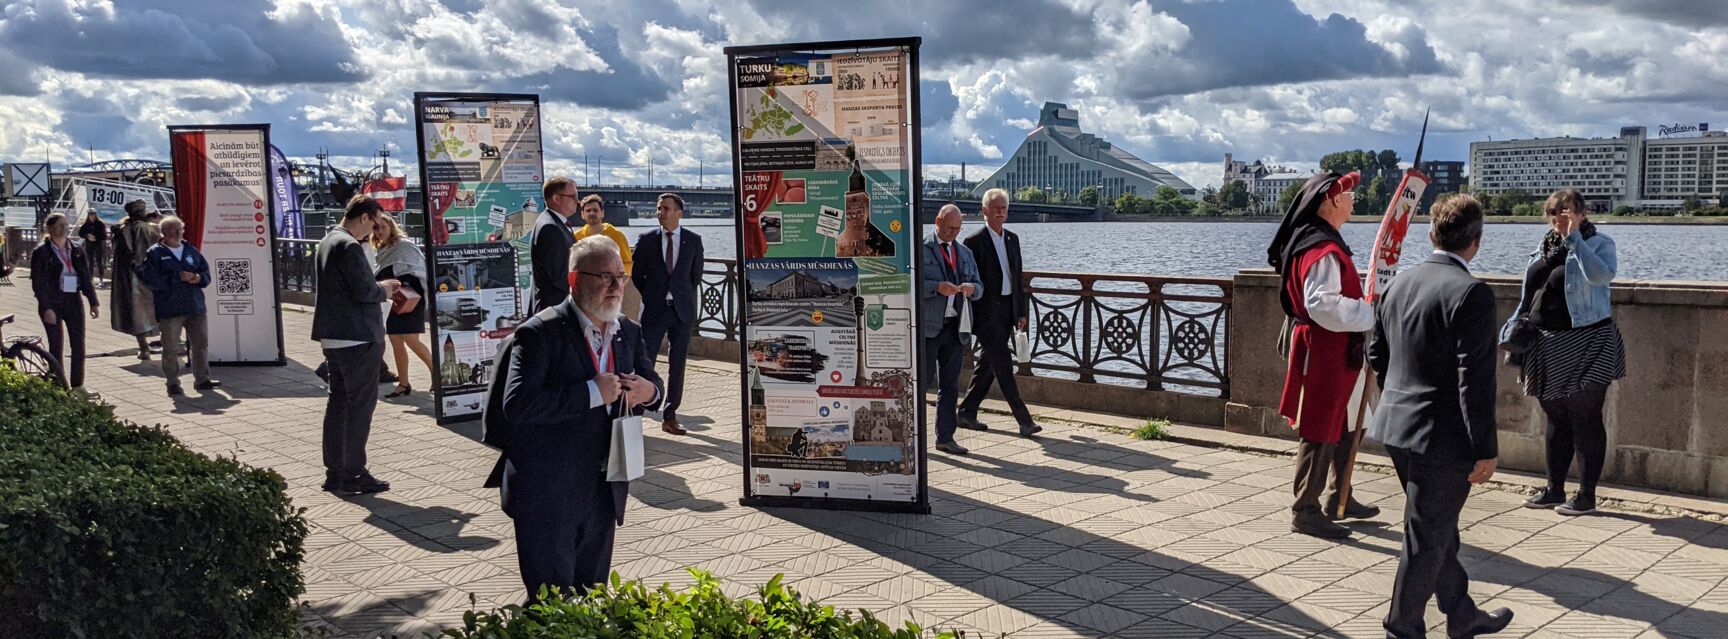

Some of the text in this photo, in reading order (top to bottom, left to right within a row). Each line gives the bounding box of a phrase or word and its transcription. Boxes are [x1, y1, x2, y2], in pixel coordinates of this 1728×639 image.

[740, 64, 771, 73] TURKU
[740, 75, 766, 83] SOMIJA
[1659, 123, 1697, 137] Radisson
[210, 142, 259, 150] Aicinām būt
[214, 151, 260, 161] atbildīgiem
[232, 160, 261, 168] ievērot
[210, 169, 261, 179] piesardzības
[213, 179, 261, 188] pasākumus!
[92, 188, 124, 205] 13:00
[433, 199, 439, 209] 1
[745, 194, 757, 211] 6
[748, 262, 780, 270] HANZAS
[808, 261, 853, 269] MŪSDIENĀS
